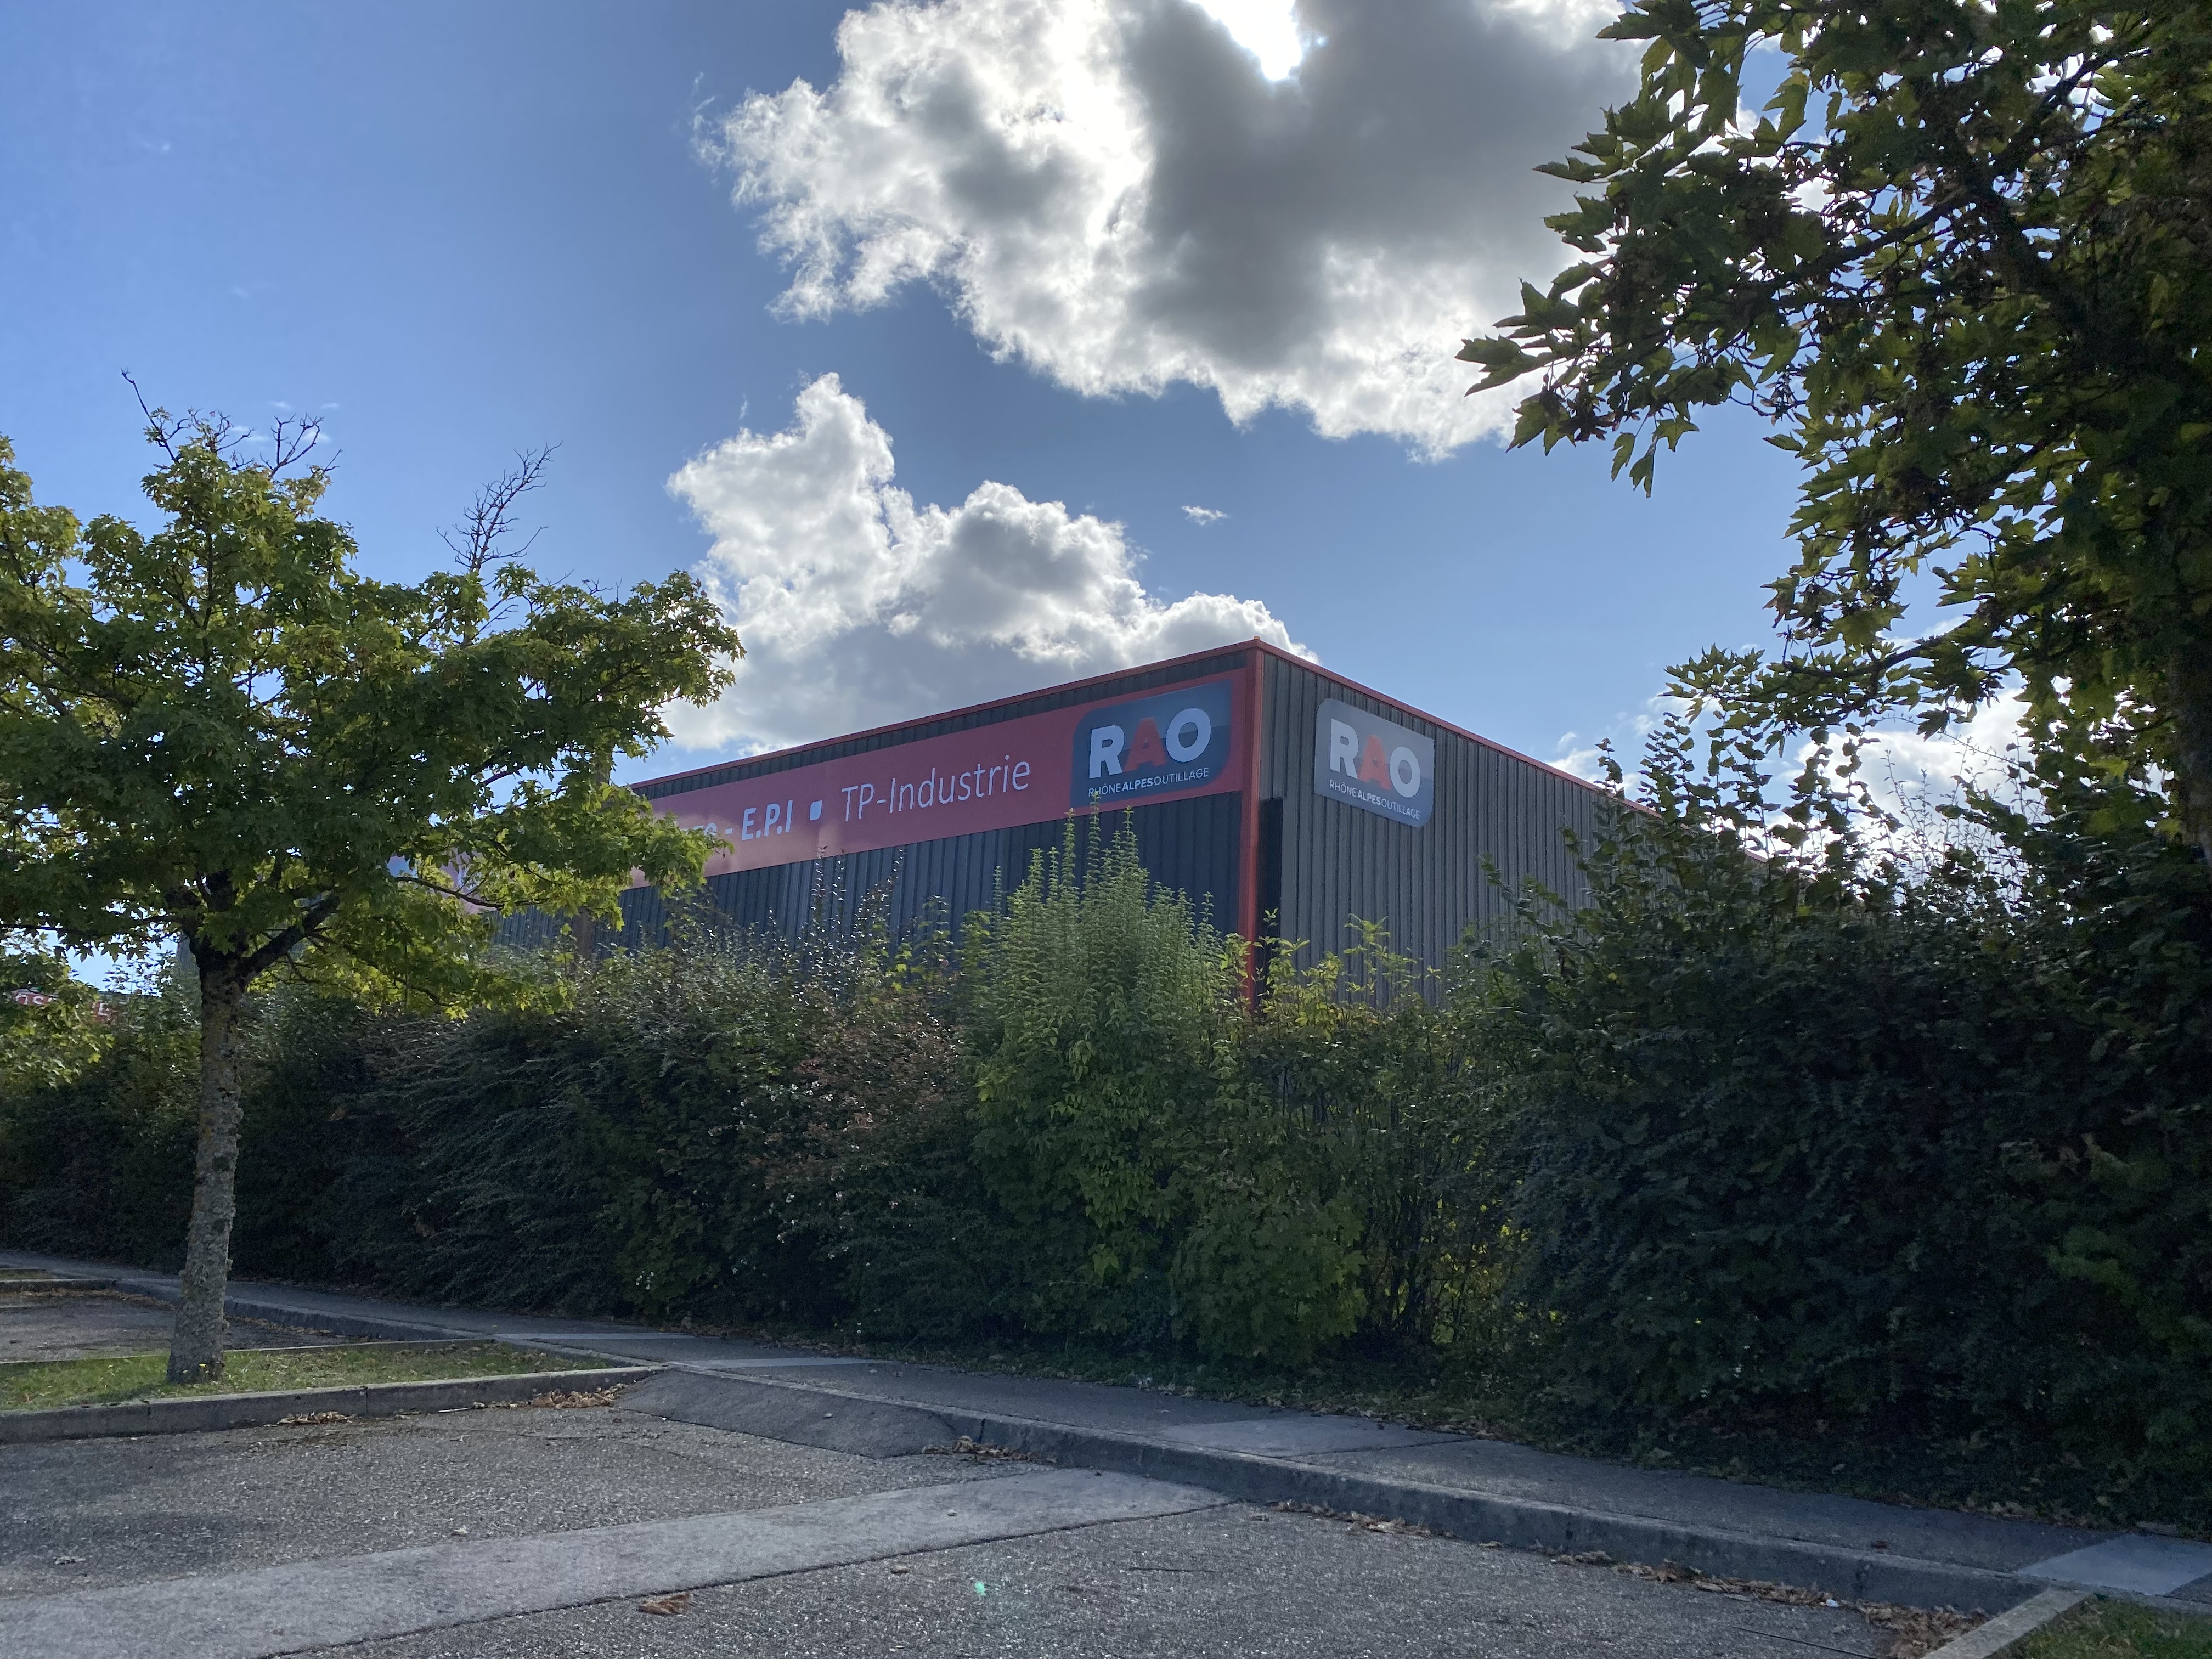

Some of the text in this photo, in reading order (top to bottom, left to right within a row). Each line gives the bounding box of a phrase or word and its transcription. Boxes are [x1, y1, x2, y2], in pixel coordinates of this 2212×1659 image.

[1089, 708, 1211, 779] RAO
[1330, 718, 1421, 798] RAO
[741, 800, 793, 841] E.P.I
[841, 755, 1031, 822] TP-Industrie
